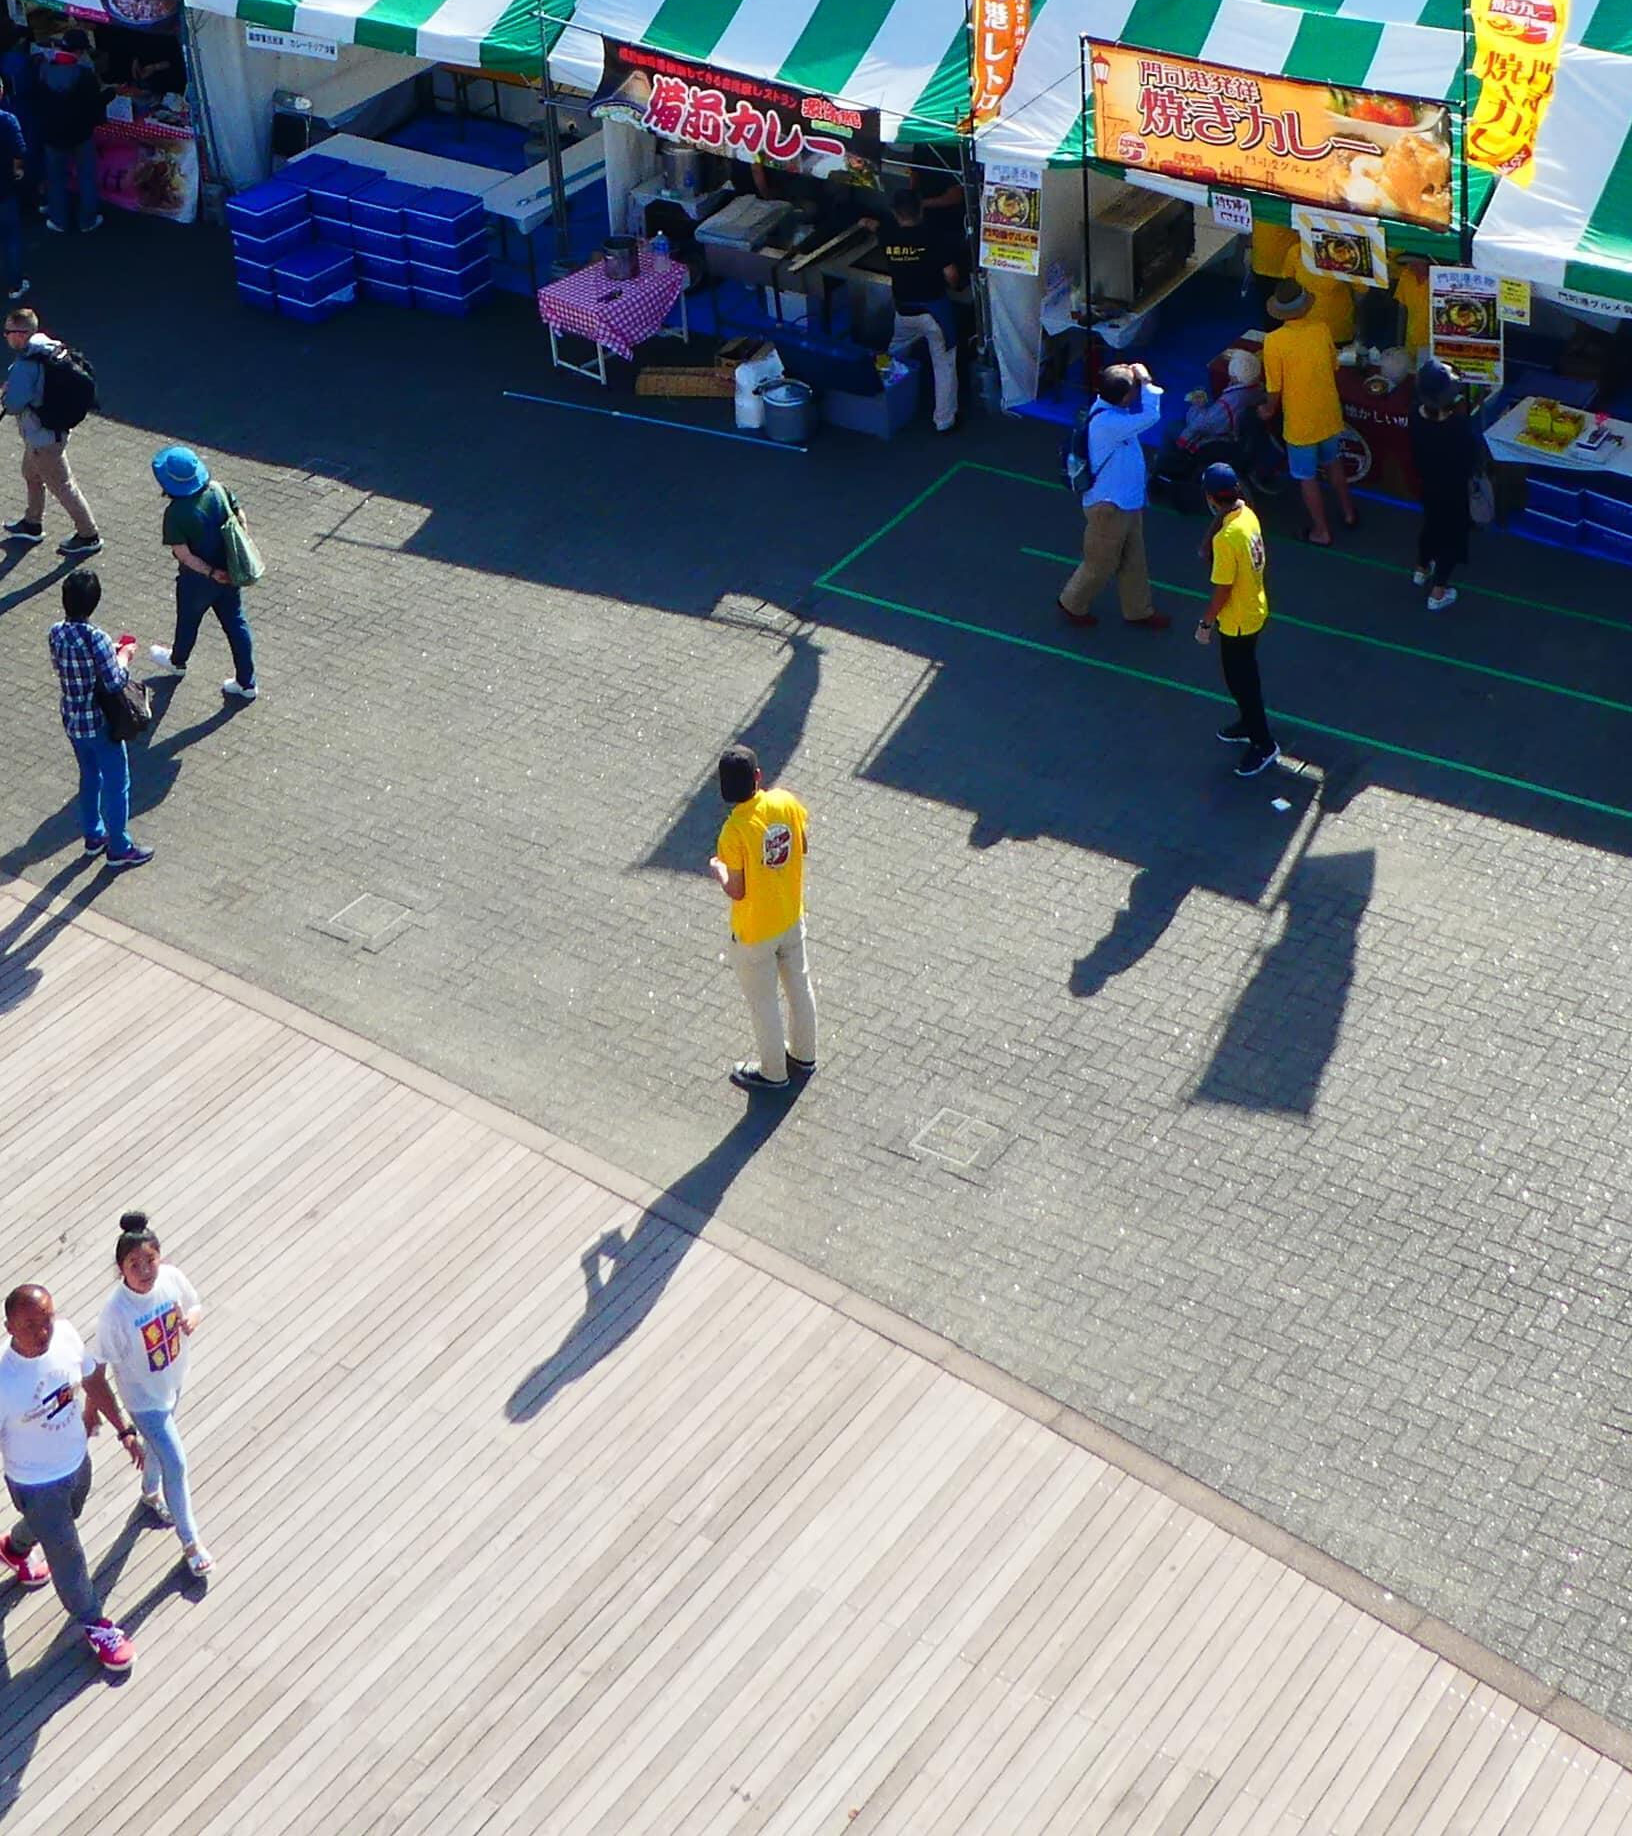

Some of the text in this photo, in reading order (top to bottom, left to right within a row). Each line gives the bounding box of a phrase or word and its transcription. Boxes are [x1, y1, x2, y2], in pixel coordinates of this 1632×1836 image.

[1138, 59, 1261, 104] 門司港発祥
[642, 75, 846, 162] 備前カレー
[1138, 88, 1383, 160] 焼きカレー
